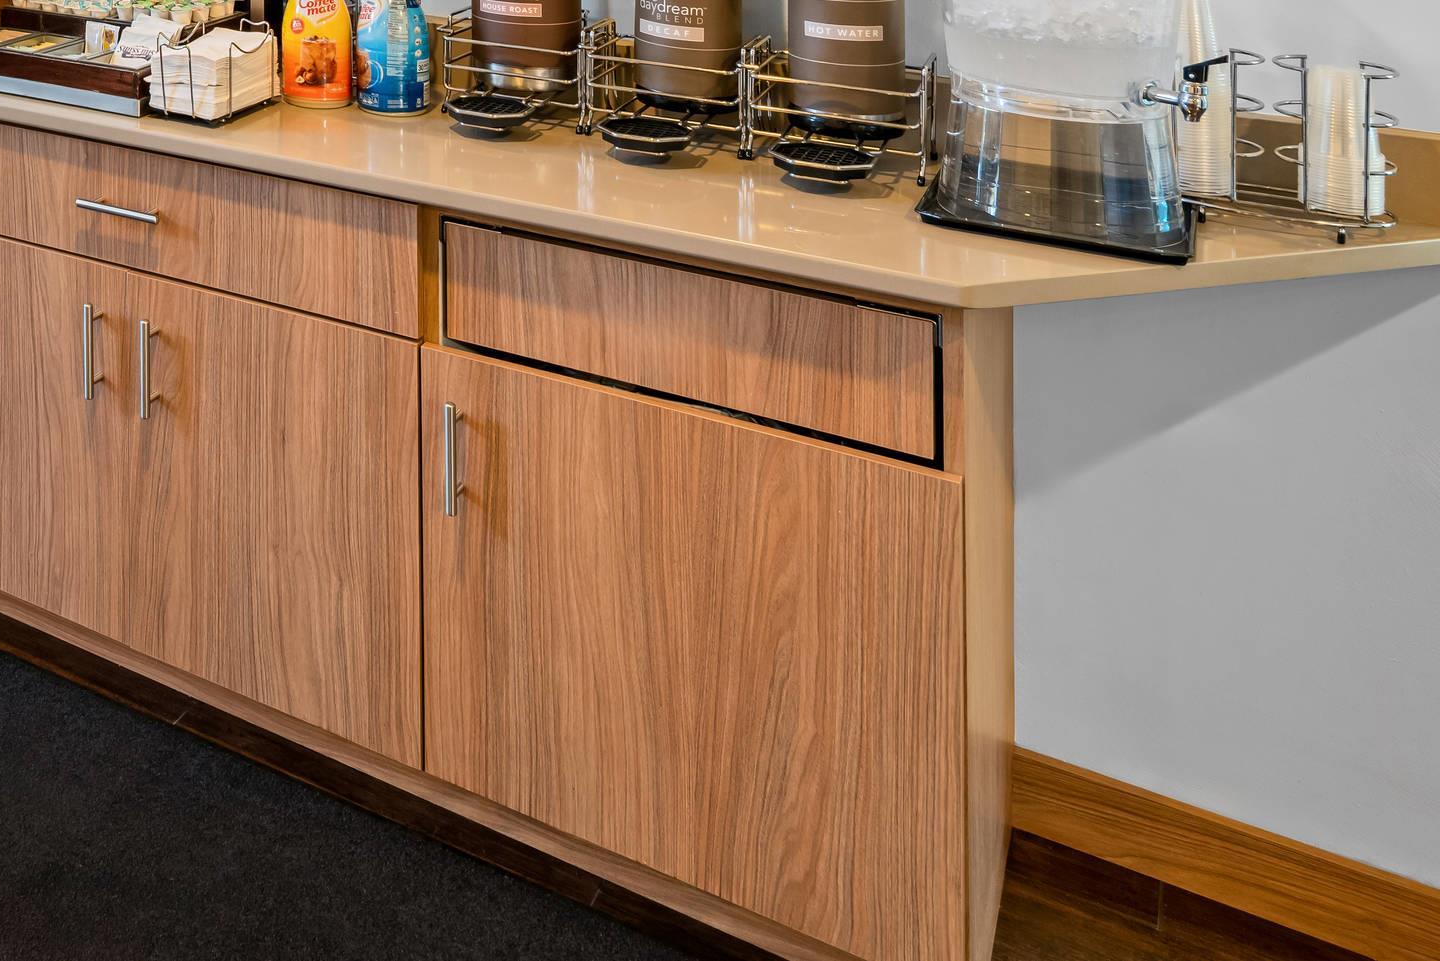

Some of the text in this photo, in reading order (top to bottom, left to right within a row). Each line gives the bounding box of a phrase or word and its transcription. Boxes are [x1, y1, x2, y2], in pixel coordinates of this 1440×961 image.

[307, 4, 337, 17] mate
[482, 1, 539, 14] HOUSE ROAST
[656, 12, 704, 25] BLEND
[647, 24, 691, 37] DECAF
[807, 24, 880, 38] HOT WATER
